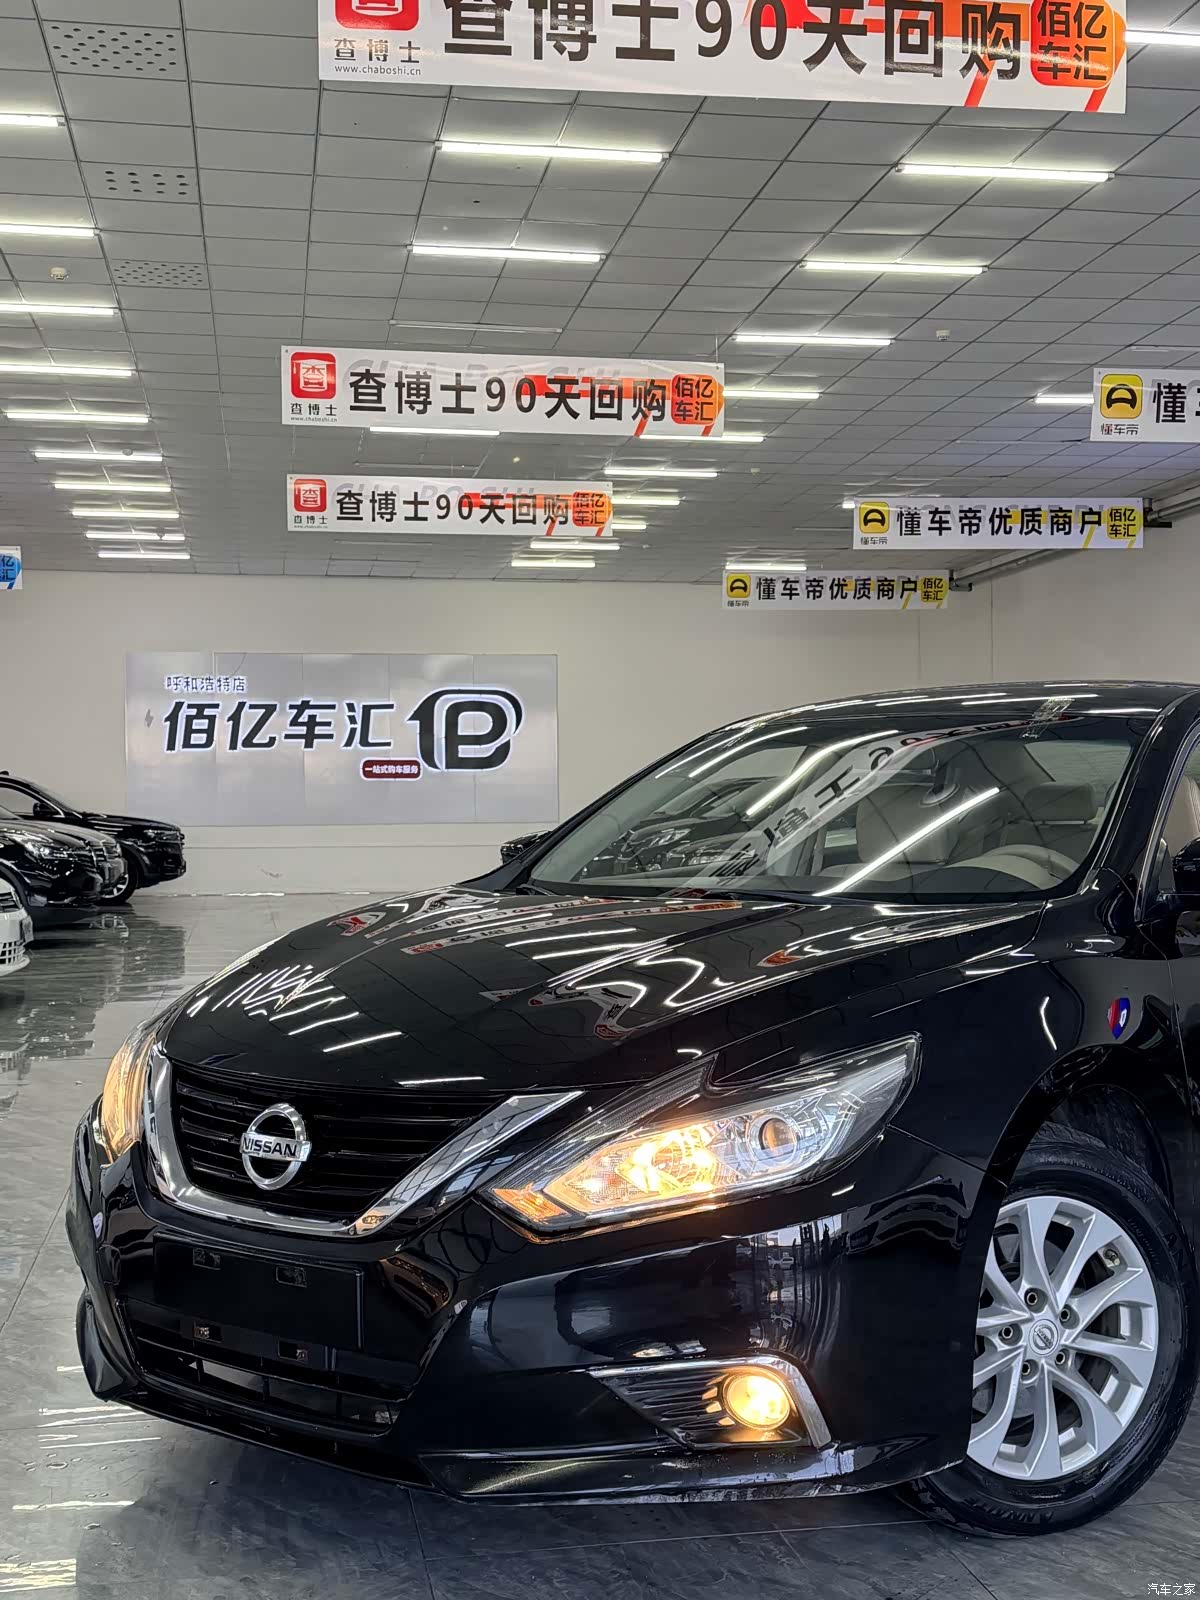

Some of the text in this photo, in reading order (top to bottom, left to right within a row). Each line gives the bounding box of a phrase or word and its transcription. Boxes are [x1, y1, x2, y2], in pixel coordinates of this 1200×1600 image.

[1037, 0, 1108, 39] 佰亿
[334, 38, 421, 64] 查博士
[1037, 41, 1108, 80] 车汇
[334, 64, 421, 76] www.chaboshi.cn
[349, 368, 666, 421] 查博士90天回购
[675, 376, 714, 399] 佰亿
[290, 403, 337, 416] 查博士
[675, 400, 714, 421] 车汇
[1152, 382, 1200, 423] 懂
[1100, 423, 1139, 435] 懂车帝
[336, 490, 569, 525] 查博士90天回购
[575, 510, 605, 525] 车汇
[1109, 508, 1136, 522] 佰亿
[897, 507, 1102, 536] 懂车帝优质商户
[1109, 523, 1136, 538] 车汇
[756, 577, 918, 600] 懂车帝优质商户
[922, 578, 943, 589] 佰亿
[922, 590, 943, 601] 车汇
[166, 676, 245, 692] 呼和浩特店
[163, 700, 395, 752] 佰亿车汇
[243, 1136, 298, 1157] NISSAN
